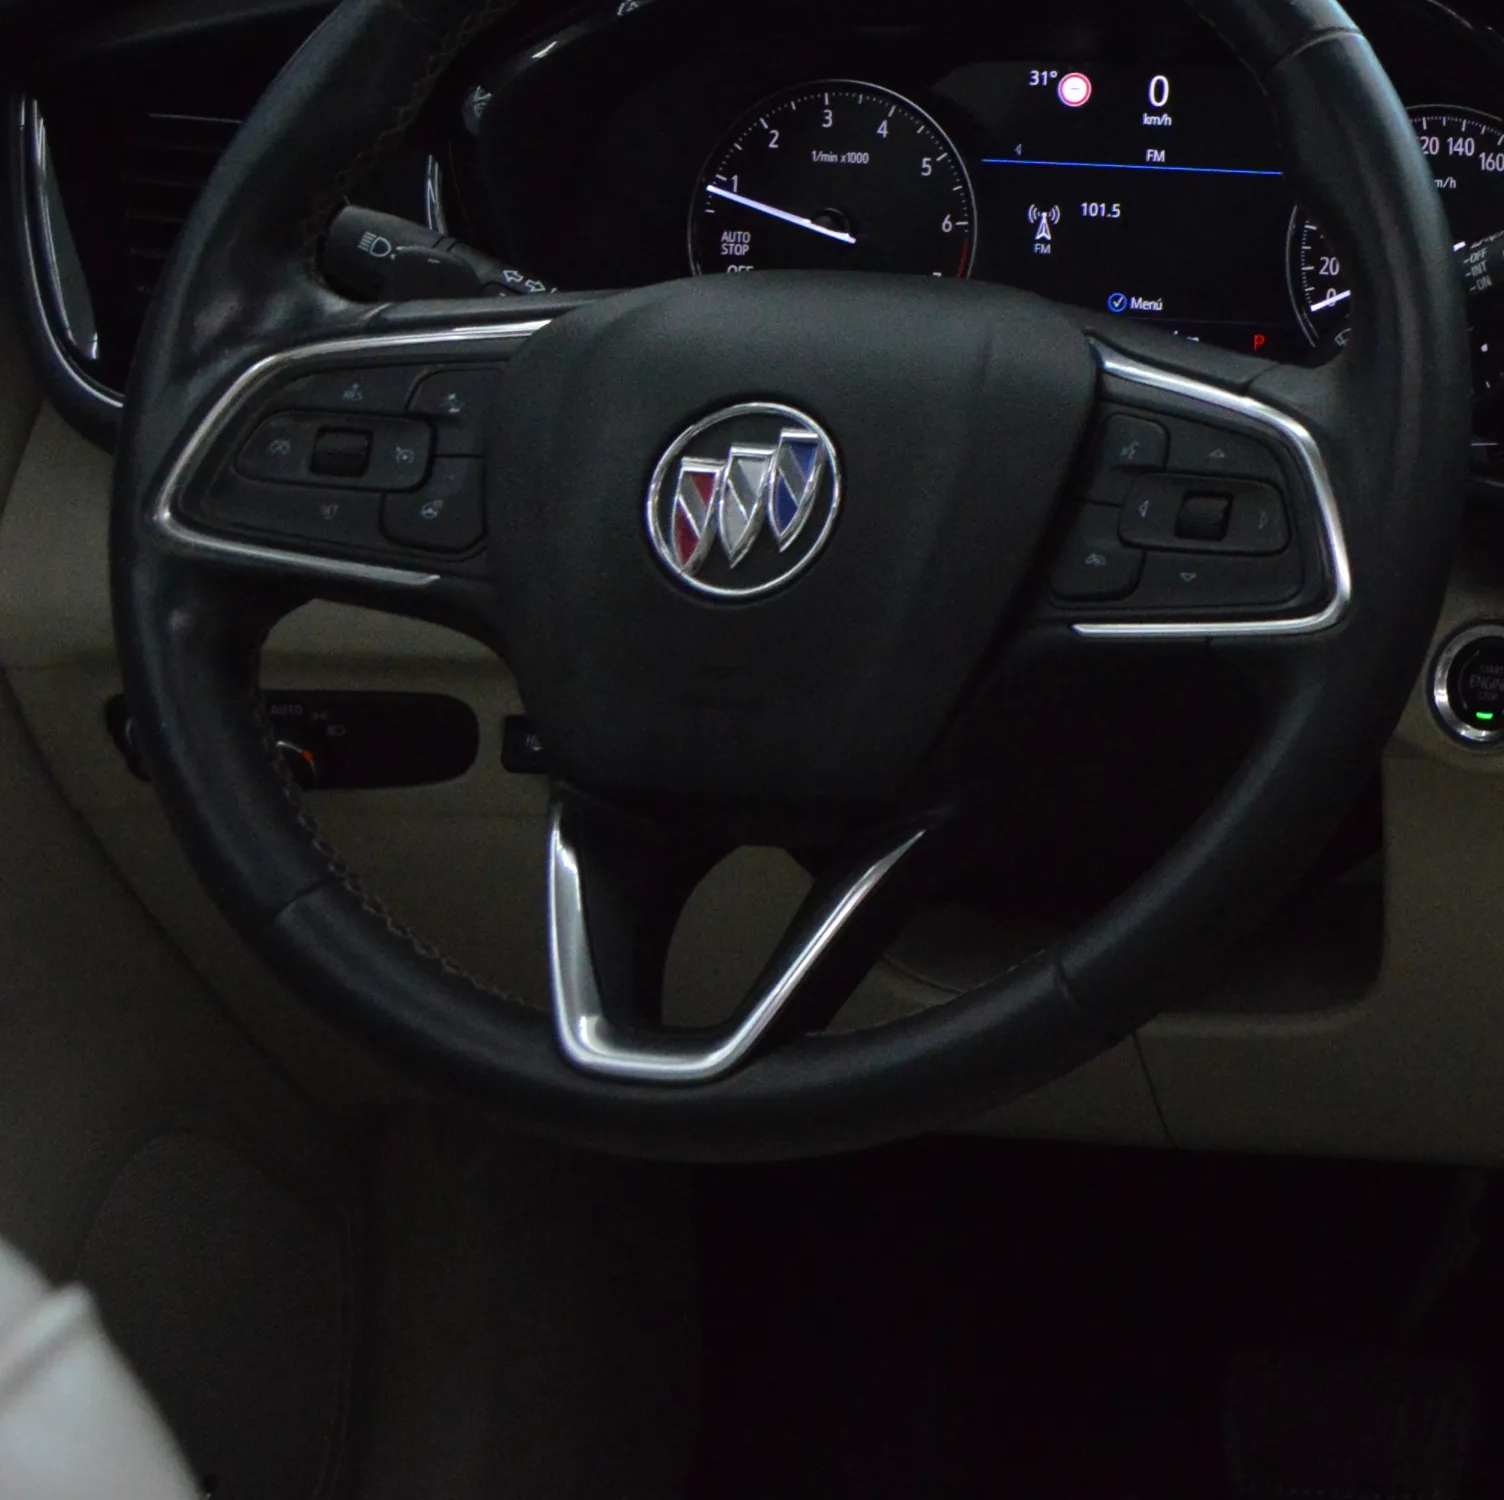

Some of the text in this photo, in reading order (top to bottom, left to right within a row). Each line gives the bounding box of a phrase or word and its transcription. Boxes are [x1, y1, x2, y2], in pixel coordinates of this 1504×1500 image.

[1029, 70, 1170, 107] 31° 0
[821, 109, 833, 128] 3
[1142, 112, 1172, 126] km/h
[876, 120, 888, 138] 4
[768, 129, 779, 149] 2
[1420, 136, 1440, 156] 20
[1447, 137, 1475, 157] 140
[811, 150, 870, 165] 1/min x1000
[1146, 149, 1166, 162] FM
[921, 157, 932, 176] 5
[731, 174, 738, 192] 1
[1434, 176, 1457, 189] m/h
[1080, 202, 1121, 218] 101.5
[941, 214, 952, 233] 6
[721, 231, 751, 243] AUTO
[721, 244, 750, 255] STOP
[1034, 243, 1051, 254] FM
[1470, 249, 1488, 264] OFF
[1319, 256, 1340, 276] 20
[1476, 275, 1493, 291] ON
[1130, 297, 1163, 311] Menú
[1254, 334, 1265, 350] P
